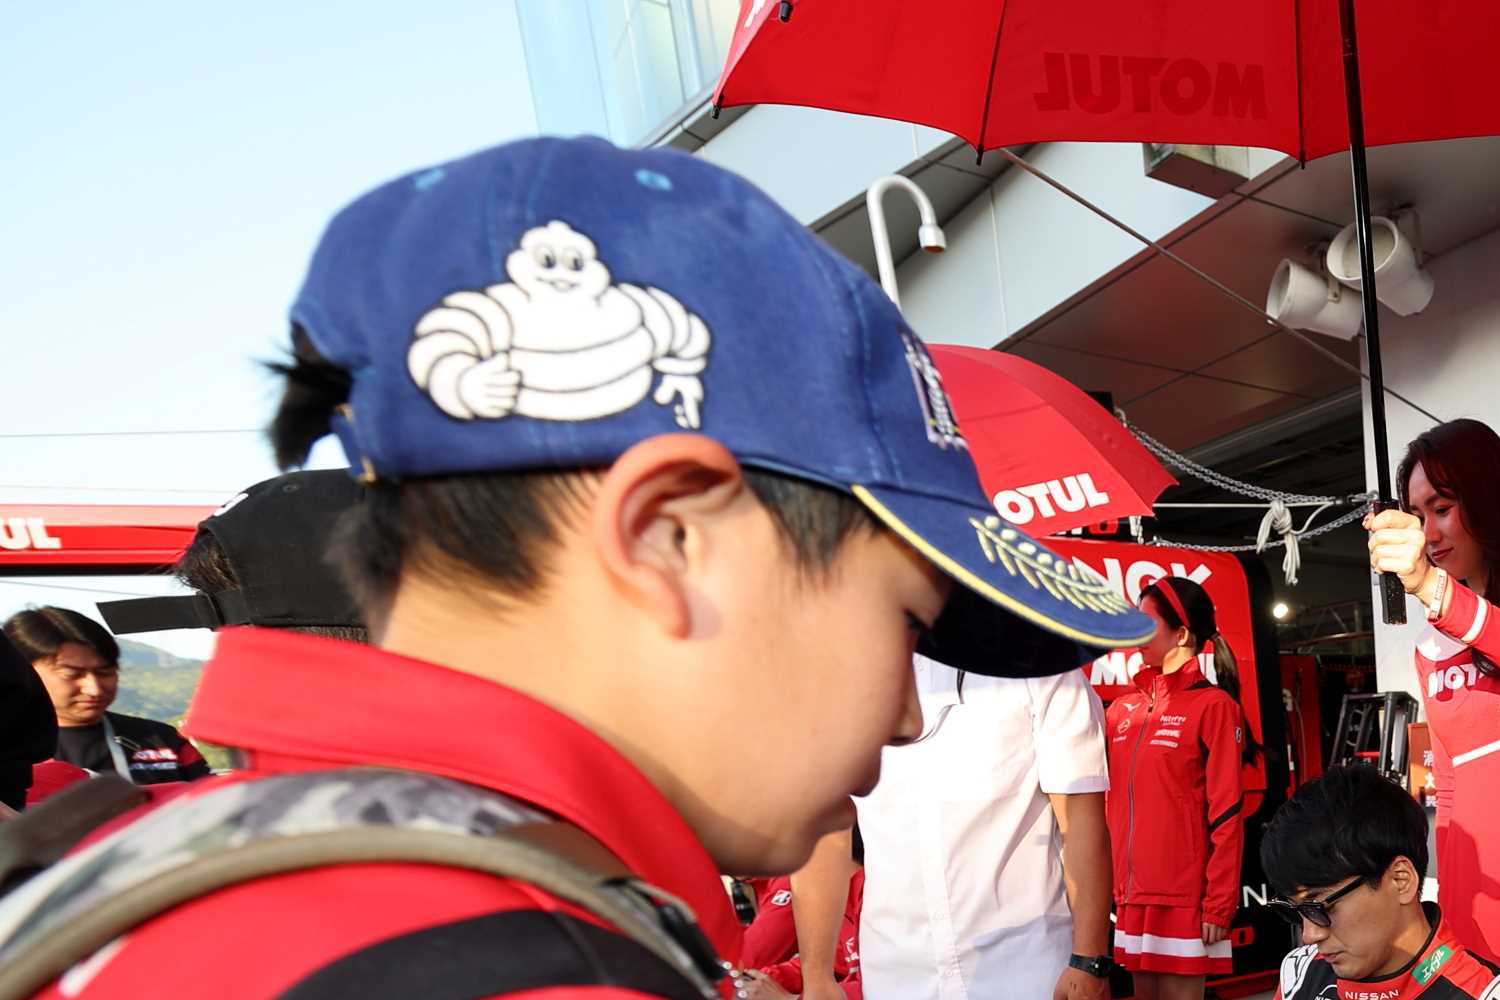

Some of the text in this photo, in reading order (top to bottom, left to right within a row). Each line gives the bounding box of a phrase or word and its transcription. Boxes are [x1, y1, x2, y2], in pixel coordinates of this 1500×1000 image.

[993, 473, 1110, 525] OTUL
[1428, 664, 1484, 698] MOT
[1345, 989, 1399, 1000] NISSAN
